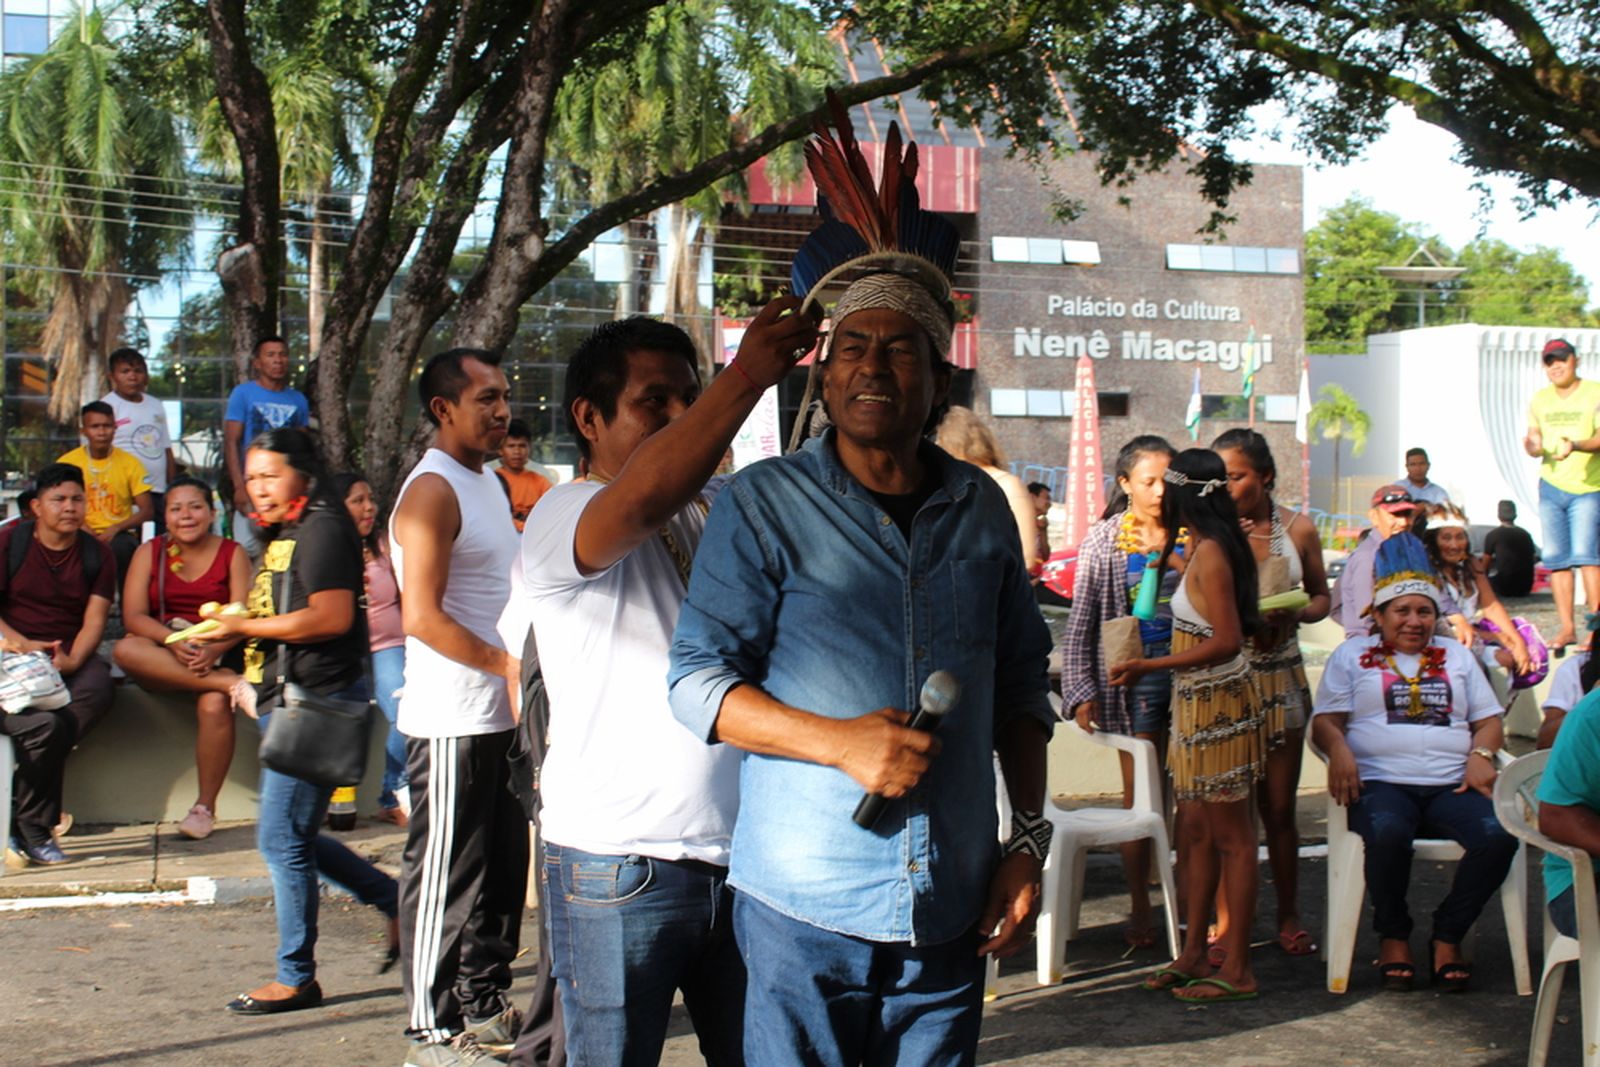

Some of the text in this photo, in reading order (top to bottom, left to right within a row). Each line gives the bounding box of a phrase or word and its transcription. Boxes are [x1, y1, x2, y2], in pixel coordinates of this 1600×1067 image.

[1047, 294, 1242, 322] Palácio da Cultura
[1013, 326, 1274, 372] Nenê Macaggi
[1081, 366, 1096, 442] PALACIO
[1083, 446, 1097, 468] DA
